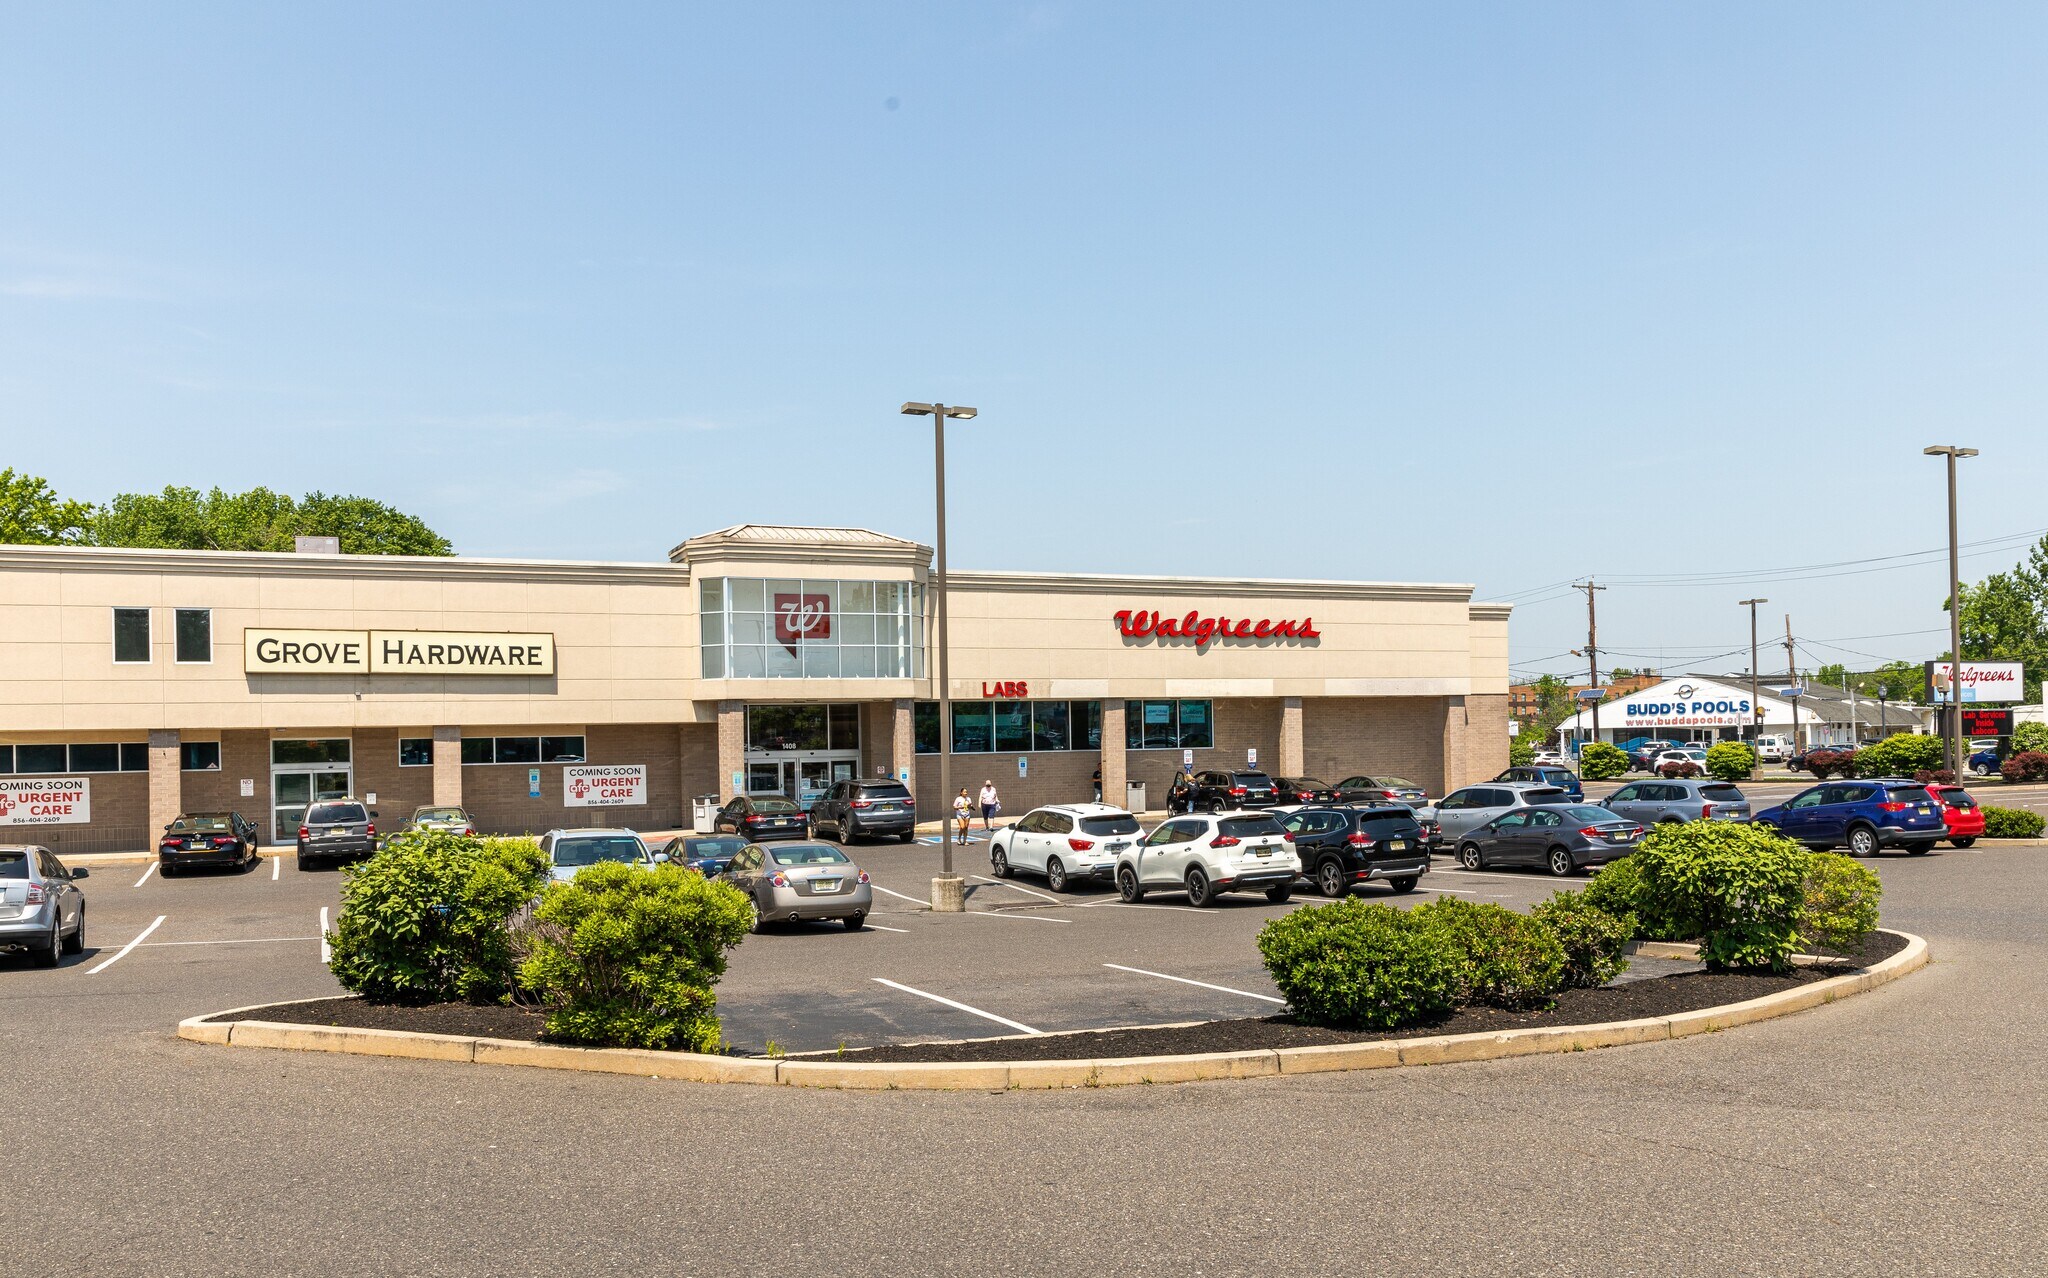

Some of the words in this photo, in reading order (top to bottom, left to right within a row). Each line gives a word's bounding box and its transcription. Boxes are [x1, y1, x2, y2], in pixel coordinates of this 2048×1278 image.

[1113, 610, 1321, 645] Walgreens
[256, 638, 361, 664] GROVE
[382, 640, 543, 666] HARDWARE
[981, 681, 1028, 698] LABS
[1627, 702, 1687, 716] BUDD'S
[1692, 700, 1750, 714] POOLS
[1963, 711, 1976, 719] Lab
[1979, 711, 2006, 719] Services
[1975, 719, 1995, 727] Inside
[1971, 727, 1999, 736] Labcorp
[569, 768, 611, 777] COMING
[613, 767, 641, 776] SOON
[0, 782, 43, 791] OMING
[47, 781, 83, 790] SOON
[591, 777, 641, 788] URGENT
[18, 792, 83, 803] URGENT
[601, 789, 633, 798] CARE
[0, 796, 15, 809] fc
[30, 805, 72, 816] CARE
[12, 816, 61, 824] 856-404-2609
